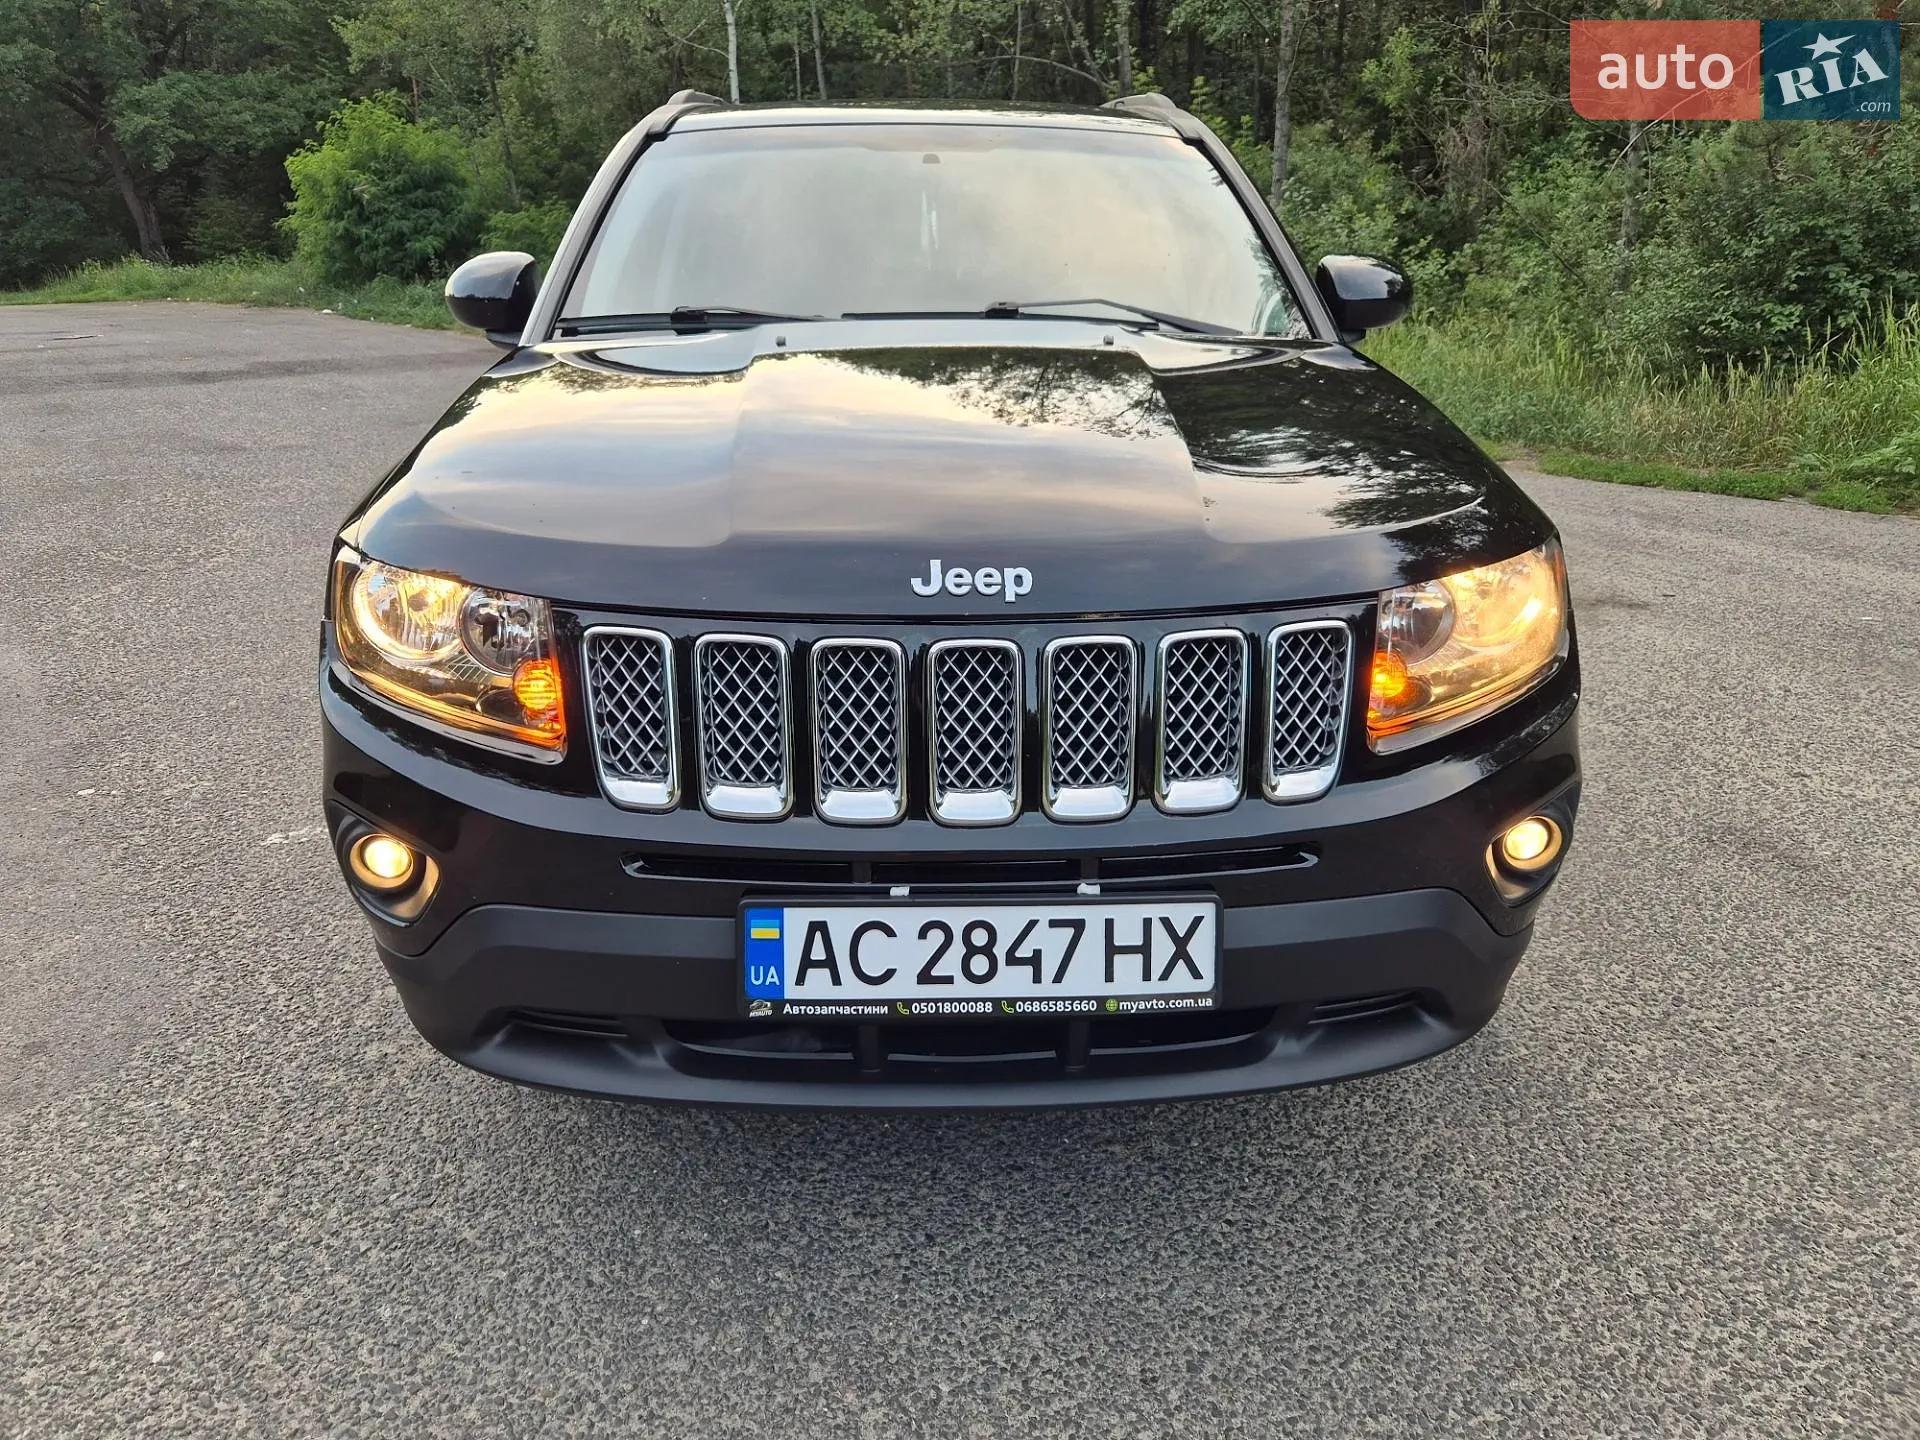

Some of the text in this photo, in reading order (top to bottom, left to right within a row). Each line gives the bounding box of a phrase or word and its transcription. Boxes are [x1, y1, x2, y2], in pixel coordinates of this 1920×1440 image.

[910, 559, 1033, 603] Jeep
[794, 915, 1205, 986] AC 2847 HX
[750, 966, 780, 985] UA
[782, 997, 1213, 1015] Автозапчастини 0501800088 0686585660 myavto.com.ua
